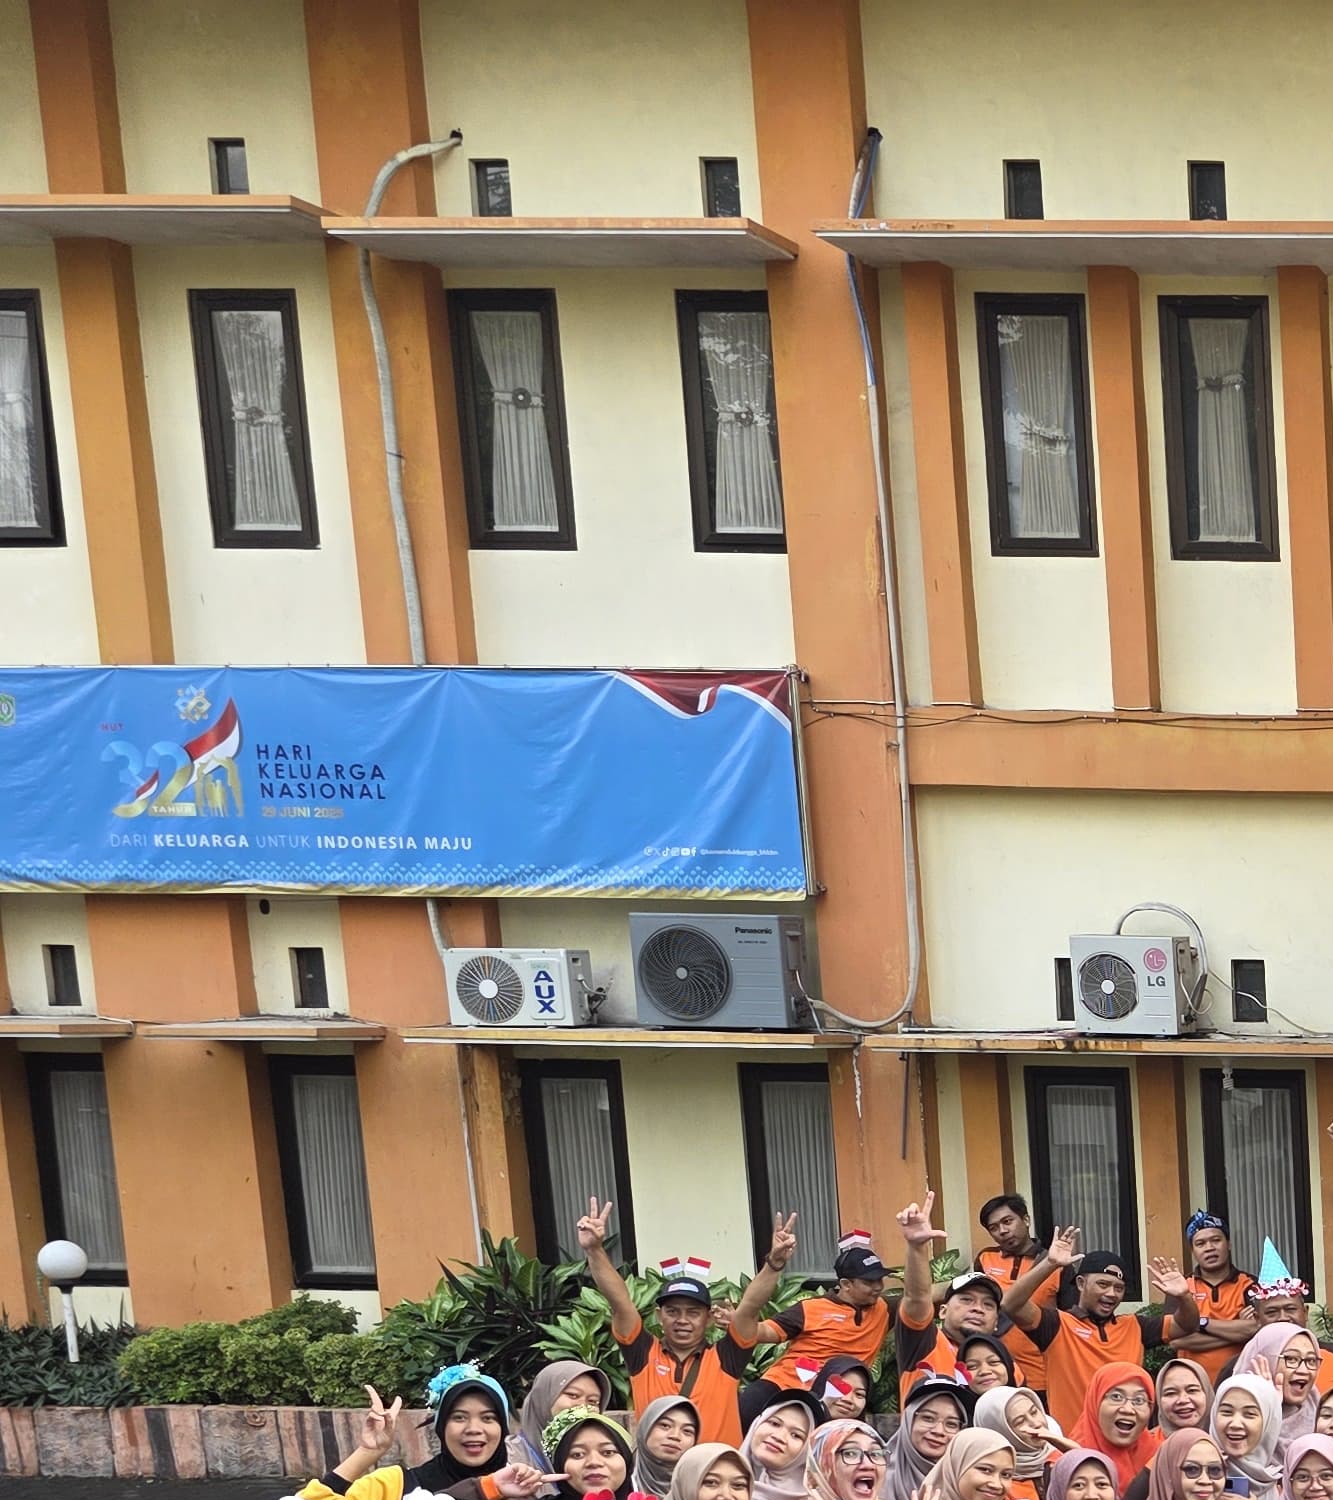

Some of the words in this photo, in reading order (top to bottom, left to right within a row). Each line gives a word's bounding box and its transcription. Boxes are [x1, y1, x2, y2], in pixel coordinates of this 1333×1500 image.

[101, 723, 124, 731] HUT
[256, 744, 312, 760] HARI
[258, 763, 386, 780] KELUARGA
[260, 782, 386, 800] NASIONAL
[281, 807, 311, 818] JUNI
[111, 834, 147, 848] DARI
[154, 834, 249, 848] KELUARGA
[256, 835, 311, 849] UNTUK
[317, 836, 417, 850] INDONESIA
[424, 837, 472, 850] MAJU
[735, 926, 772, 935] Panasonic
[1147, 976, 1166, 987] LG
[533, 970, 557, 1013] AUX
